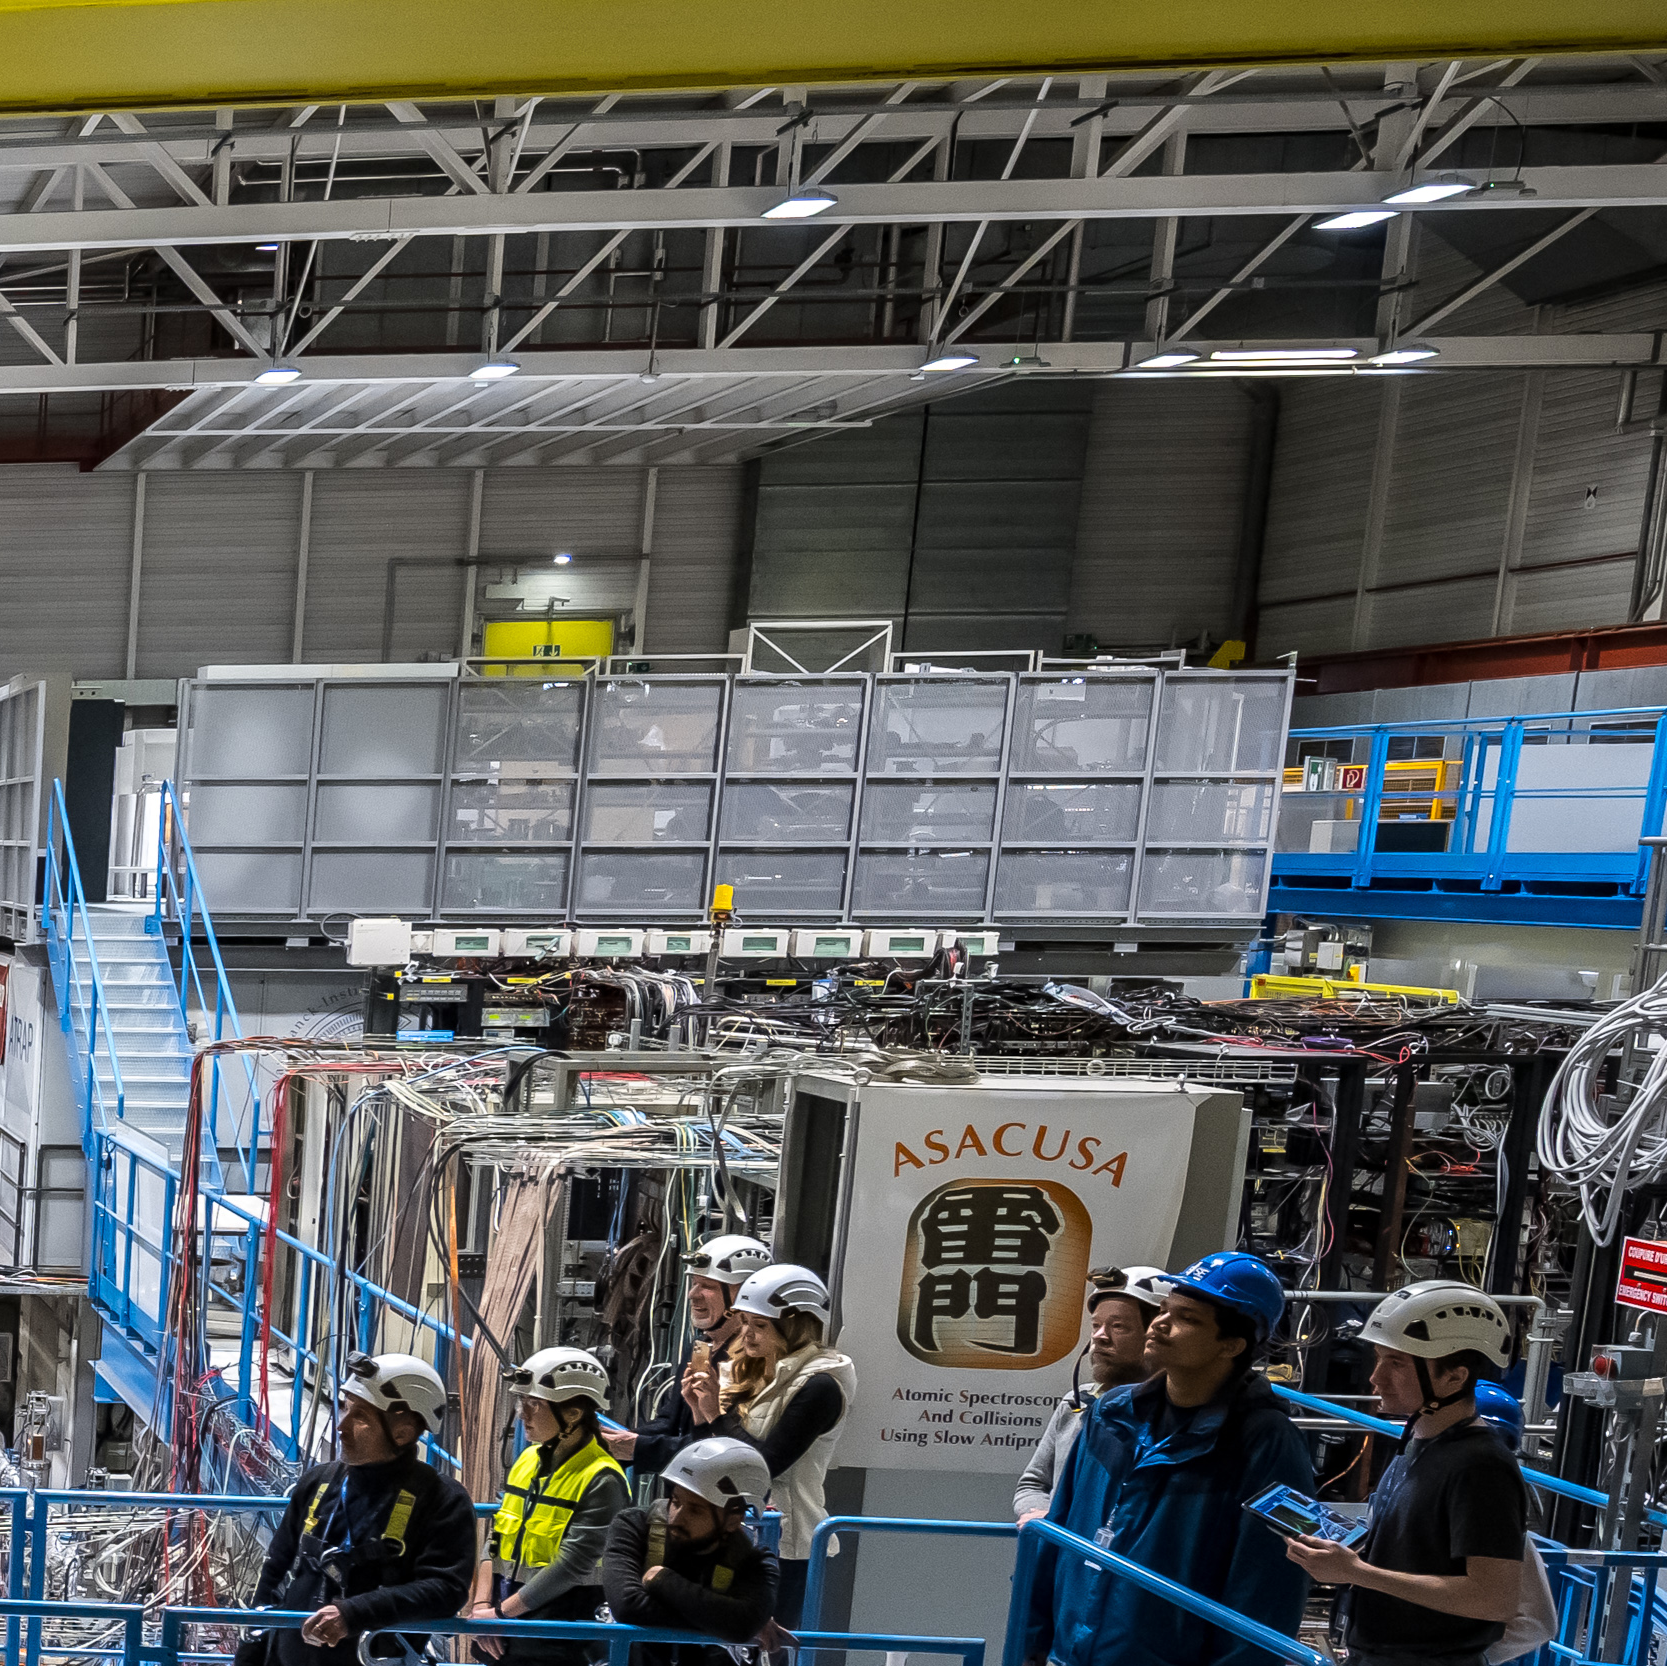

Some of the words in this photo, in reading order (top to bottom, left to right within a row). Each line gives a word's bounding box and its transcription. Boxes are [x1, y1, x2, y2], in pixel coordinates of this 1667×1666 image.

[8, 1014, 33, 1063] ATRAP
[893, 1122, 1129, 1188] ASACUSA
[1628, 1246, 1655, 1262] COUPURE
[1619, 1285, 1652, 1302] EMERGENCY
[892, 1387, 954, 1404] Atomic
[959, 1389, 1064, 1409] Spectroscop
[918, 1409, 955, 1424] And
[959, 1410, 1042, 1427] Collisions
[880, 1428, 929, 1448] Using
[933, 1429, 976, 1446] Slow
